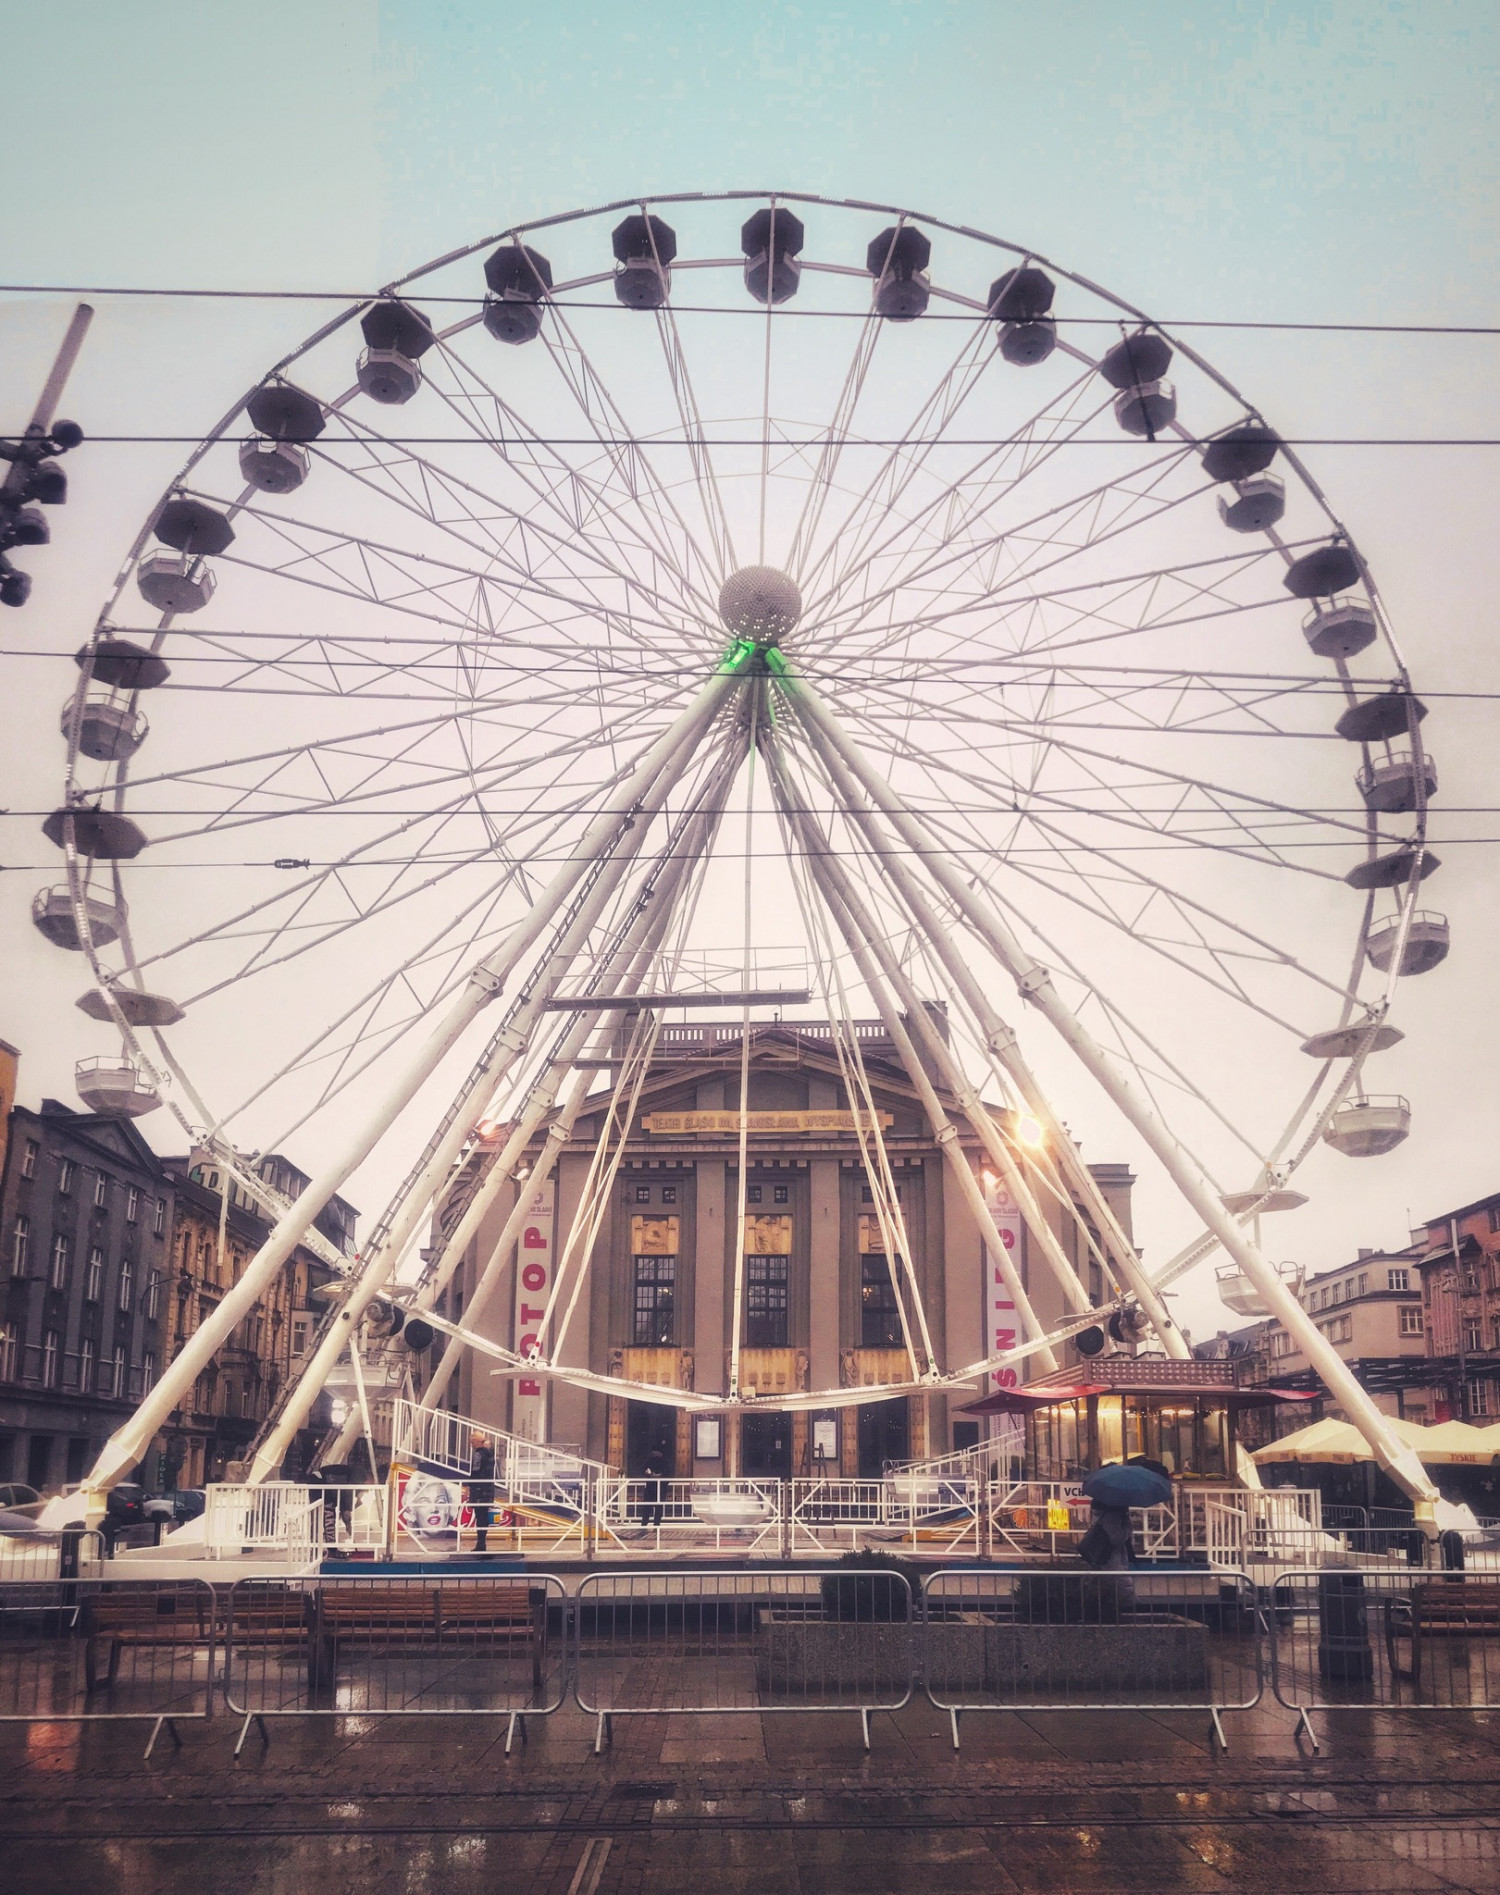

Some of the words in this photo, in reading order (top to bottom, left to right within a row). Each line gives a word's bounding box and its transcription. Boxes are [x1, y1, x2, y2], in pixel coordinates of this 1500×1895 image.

[736, 1115, 800, 1130] SANISŁAWA
[991, 1228, 1018, 1388] ŚNIG
[1449, 1453, 1477, 1463] TYSKIE
[1064, 1487, 1085, 1497] VCH
[324, 1502, 336, 1543] YAKUZ
